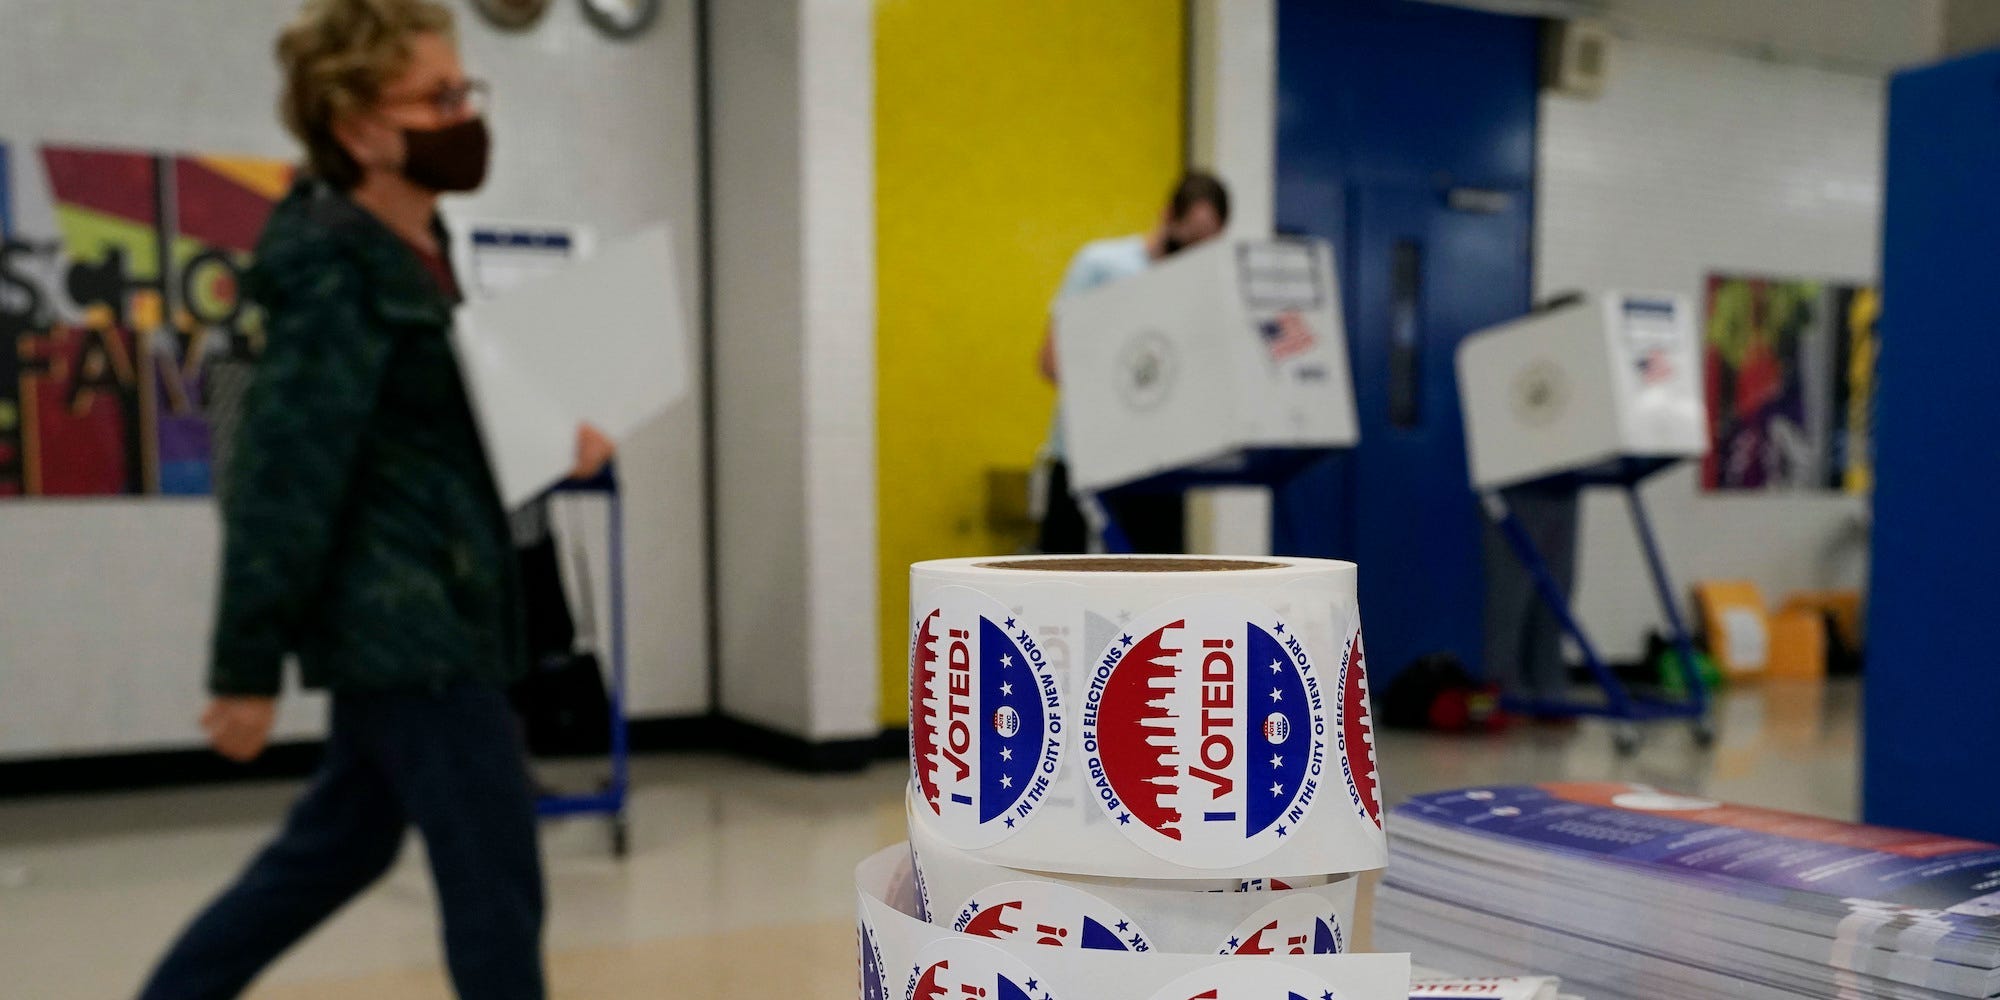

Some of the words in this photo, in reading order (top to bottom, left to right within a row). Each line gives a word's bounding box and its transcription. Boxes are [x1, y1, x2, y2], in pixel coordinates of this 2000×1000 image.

[1016, 629, 1047, 672] YORK
[1285, 634, 1311, 675] YORK
[1040, 674, 1060, 708] NEW
[1083, 647, 1123, 727] ELECTIONS
[1306, 676, 1322, 711] NEW
[1336, 650, 1349, 726] ELECTIONS
[942, 628, 971, 782] VOTED!
[1188, 638, 1235, 800] VOTED!
[1049, 712, 1062, 734] OF
[1314, 716, 1324, 736] OF
[1043, 738, 1061, 774] CITY
[1083, 730, 1097, 753] OF
[1311, 740, 1324, 776] CITY
[1338, 732, 1345, 752] OF
[1027, 775, 1050, 802] THE
[1087, 757, 1121, 811] BOARD
[1298, 779, 1317, 806] THE
[1341, 755, 1360, 806] BOARD
[951, 792, 973, 806] I
[1016, 799, 1033, 818] IN
[1287, 805, 1304, 825] IN
[1203, 811, 1237, 822] I
[1128, 932, 1149, 952] RK
